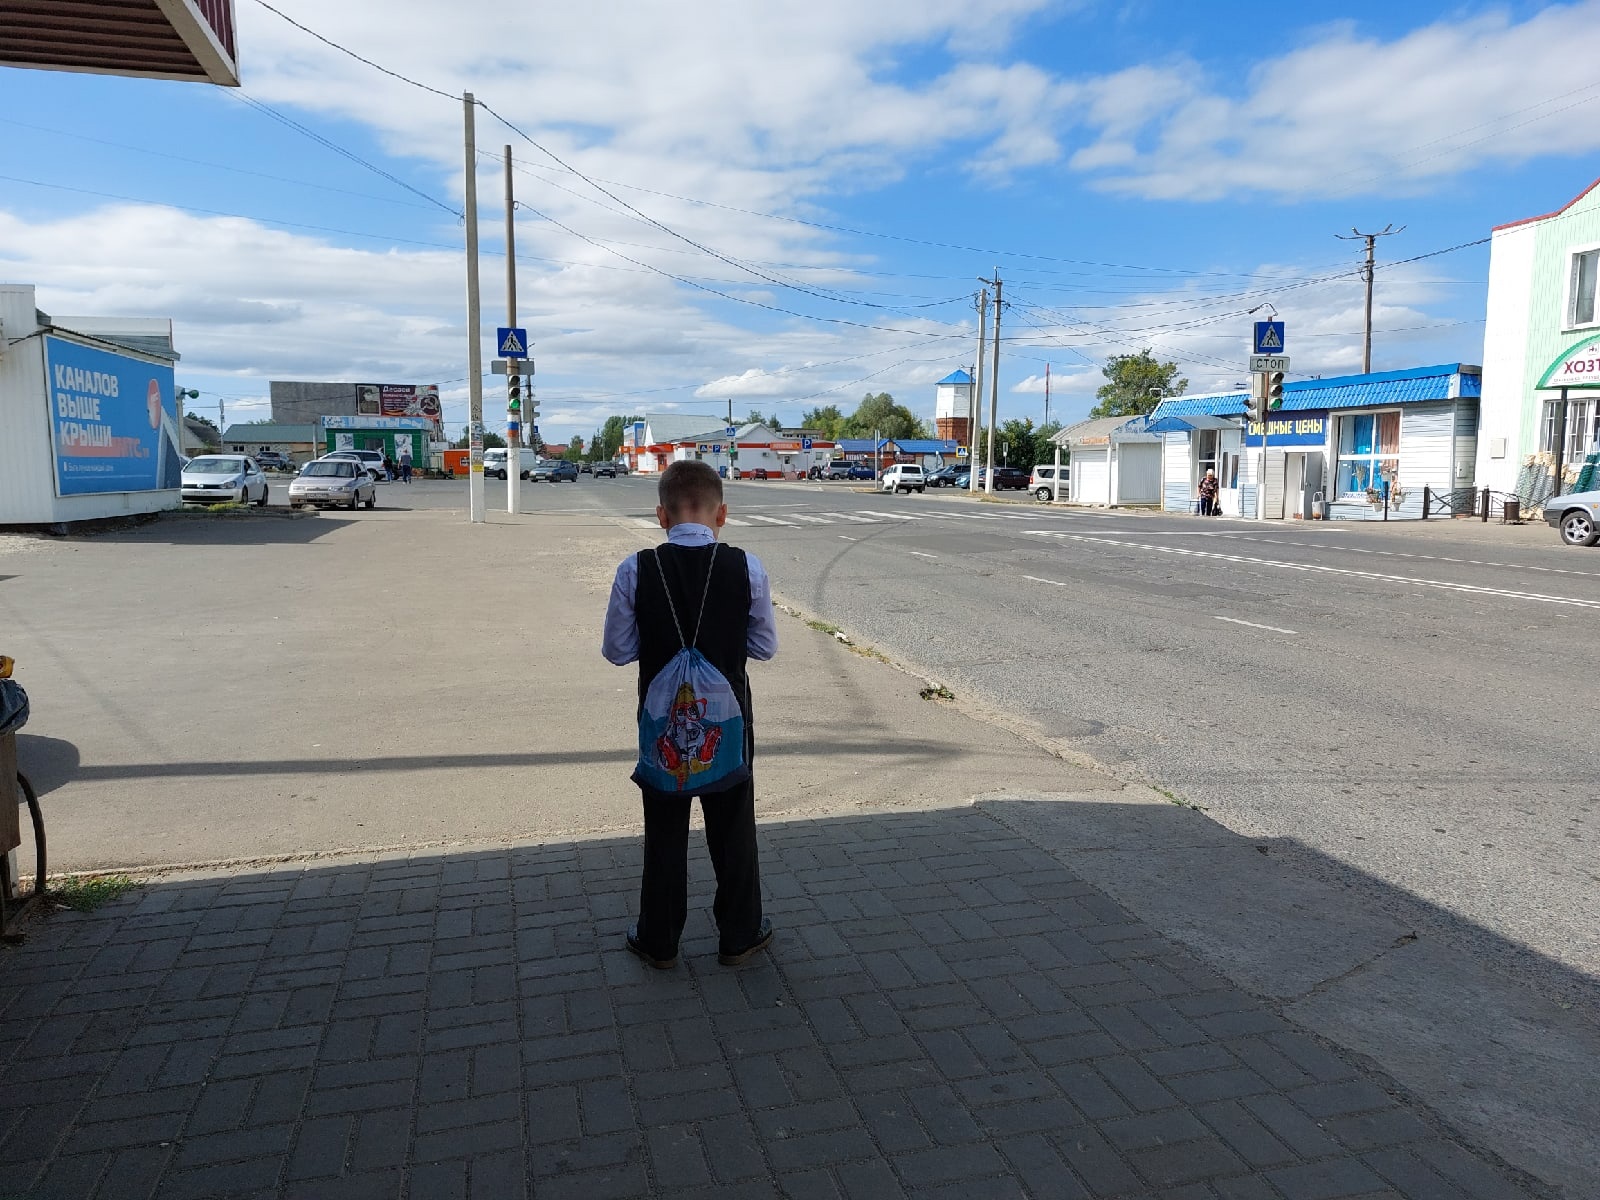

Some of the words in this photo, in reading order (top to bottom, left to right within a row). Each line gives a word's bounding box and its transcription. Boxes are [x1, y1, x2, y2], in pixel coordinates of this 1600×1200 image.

[1256, 358, 1284, 369] СТОП
[55, 364, 119, 398] КАНАЛОВ
[57, 392, 101, 421] ВЫШЕ
[60, 420, 112, 448] КРЫШИ
[1295, 418, 1323, 435] ЦЕНЫ
